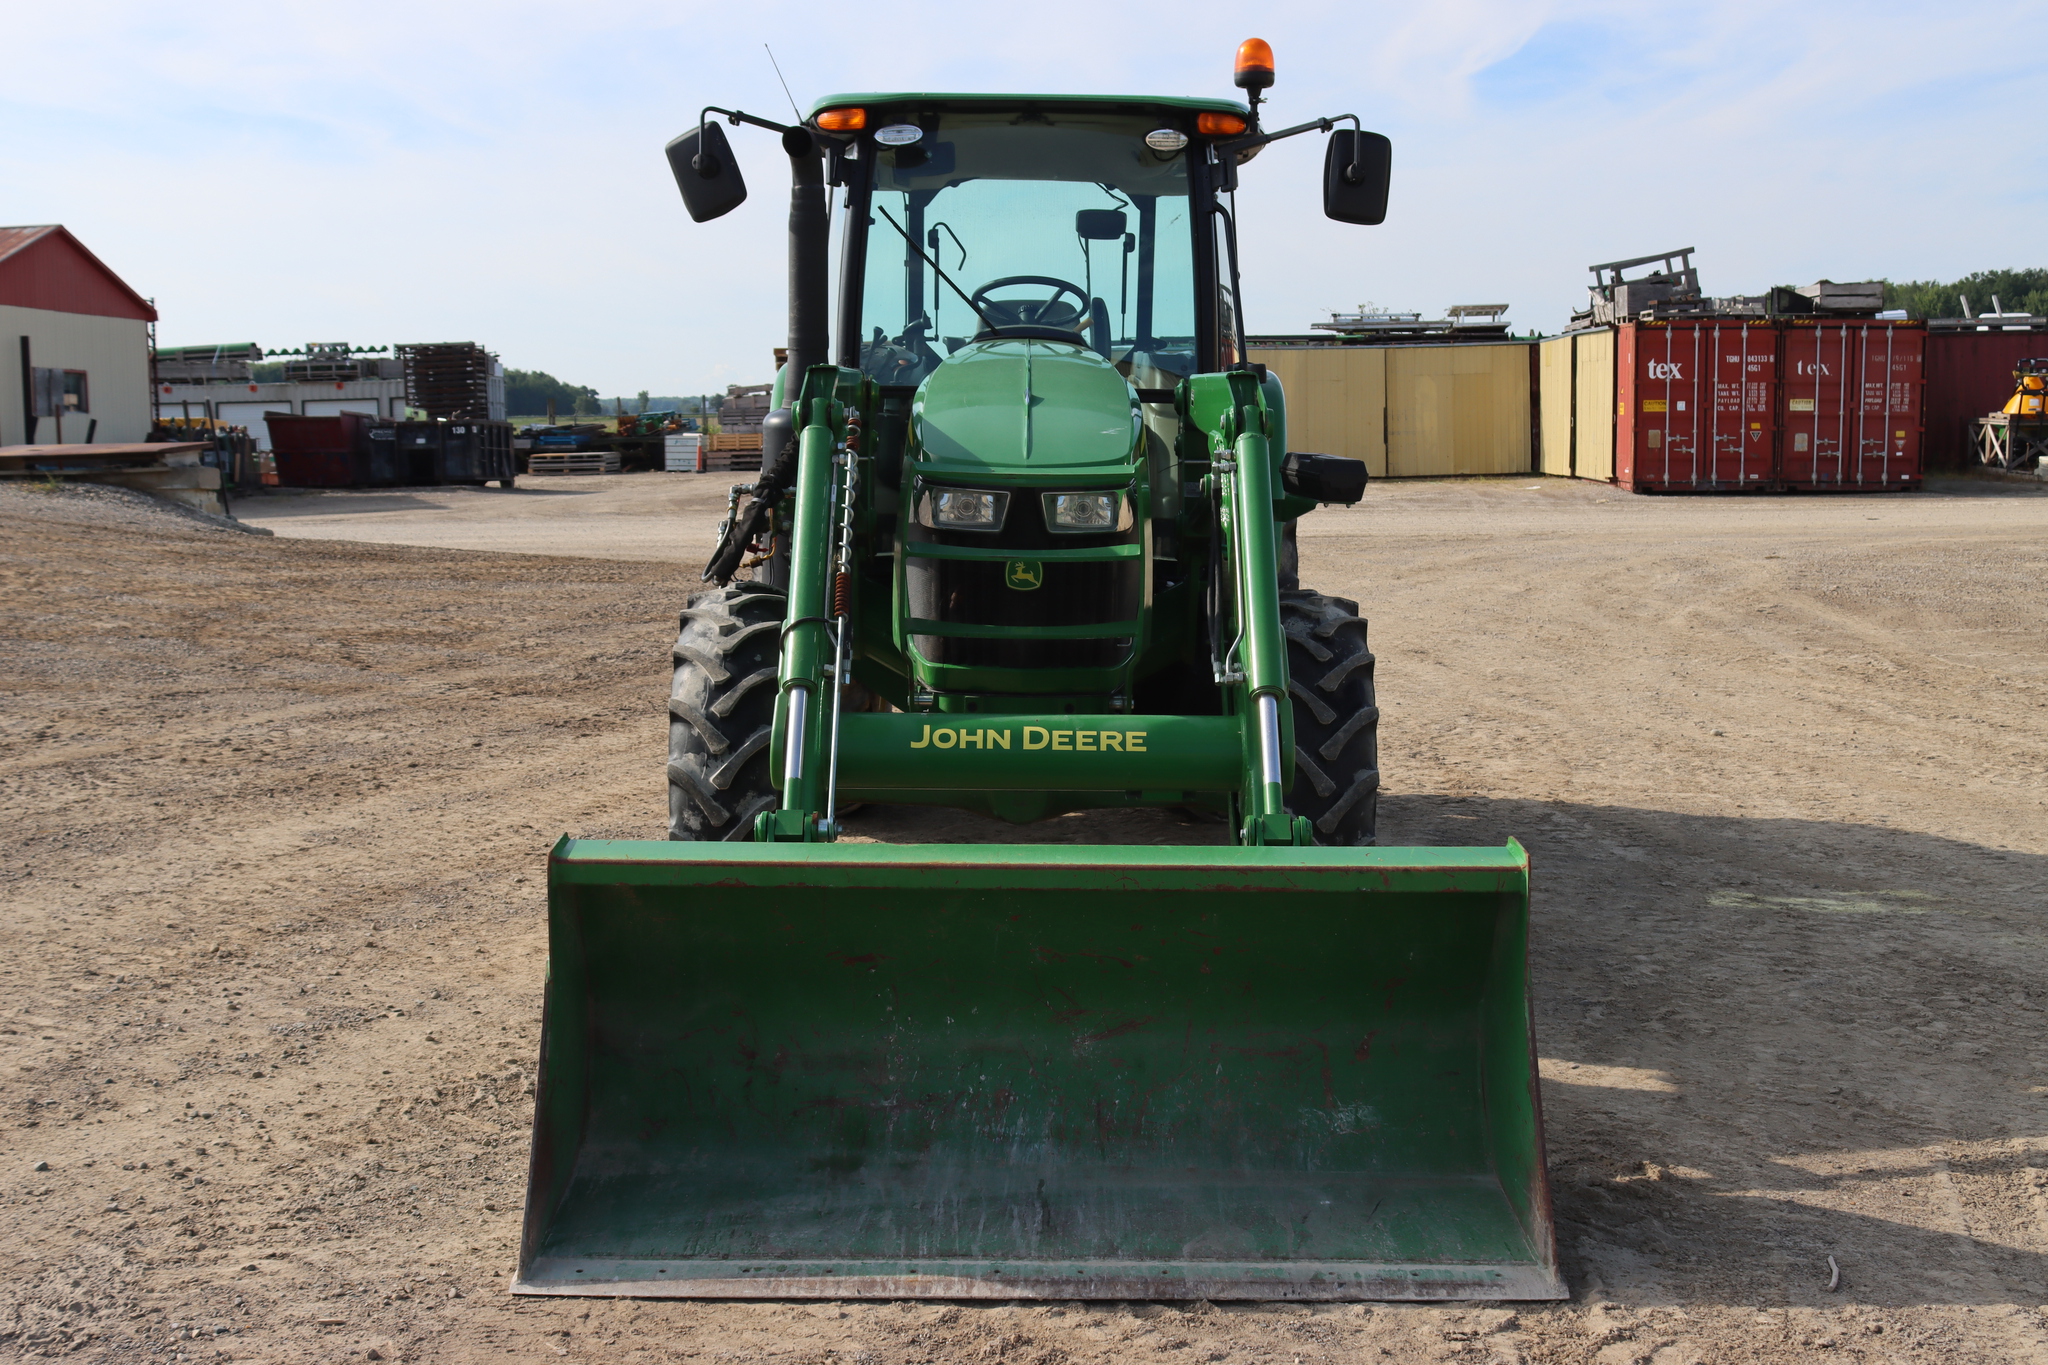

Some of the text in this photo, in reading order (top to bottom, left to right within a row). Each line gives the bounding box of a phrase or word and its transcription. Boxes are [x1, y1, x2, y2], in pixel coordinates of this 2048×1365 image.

[1726, 355, 1740, 363] TGHU
[1747, 355, 1767, 363] 843133
[1647, 358, 1683, 380] tex
[1747, 364, 1761, 372] 45G1
[1797, 360, 1830, 376] tex
[452, 426, 466, 434] 130
[910, 724, 1147, 752] JOHN DEERE
